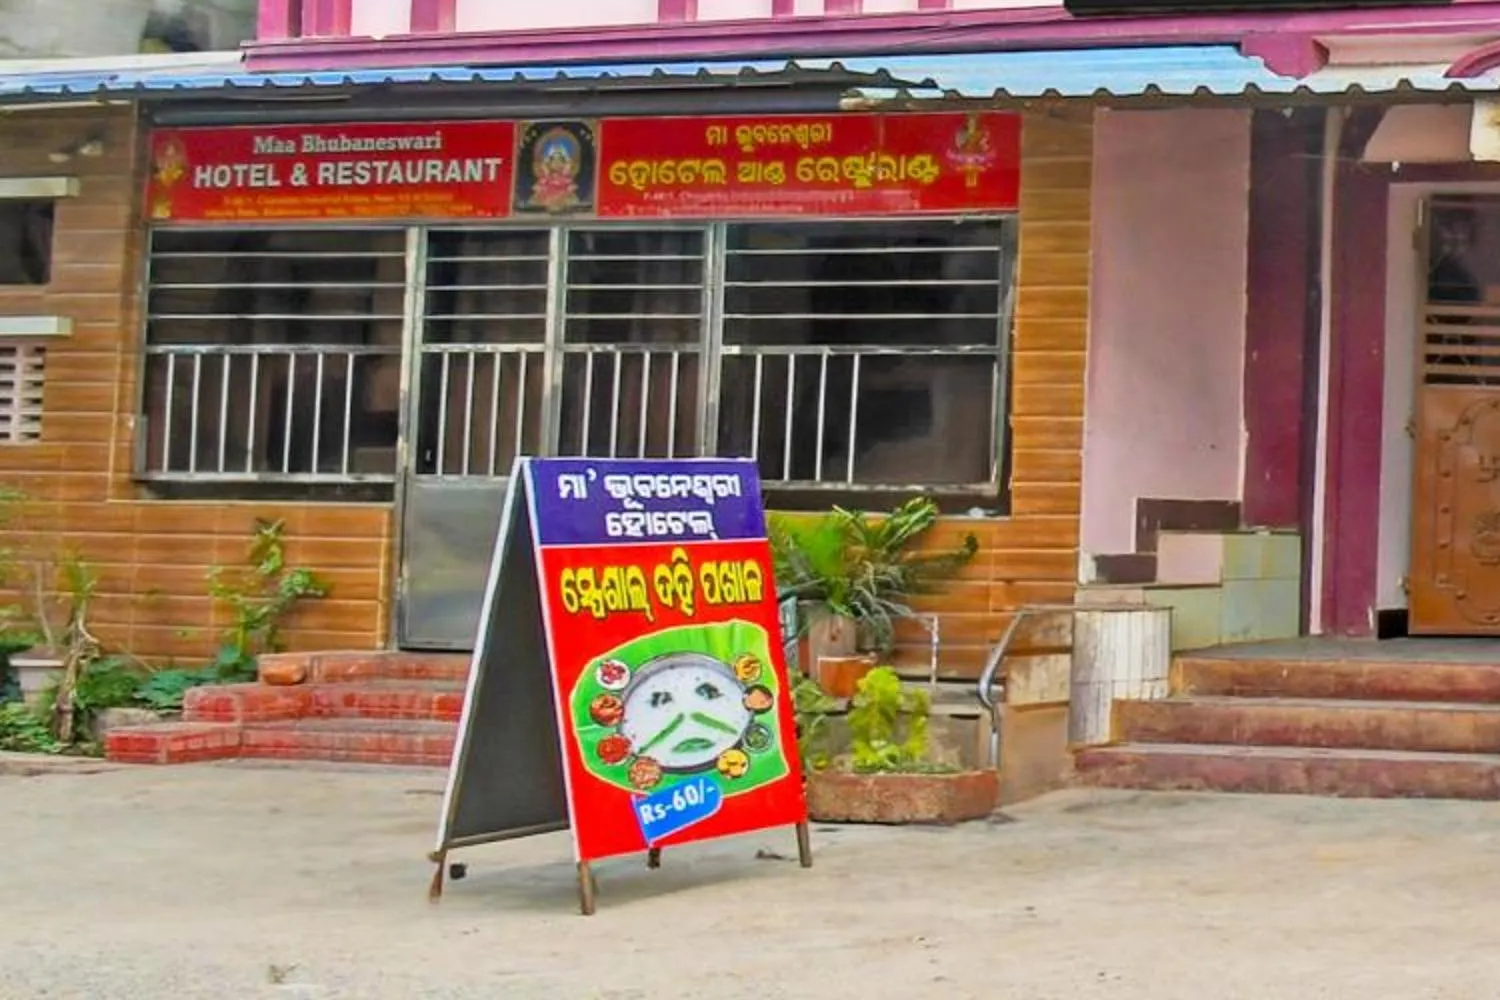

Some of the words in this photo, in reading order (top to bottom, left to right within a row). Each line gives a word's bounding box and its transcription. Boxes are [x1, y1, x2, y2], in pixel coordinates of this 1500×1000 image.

[253, 136, 296, 154] Maa
[301, 131, 442, 153] Bhubaneswari
[194, 163, 282, 188] HOTEL
[290, 162, 309, 187] &
[317, 158, 502, 186] RESTAURANT
[640, 777, 716, 825] Rs-60/-
